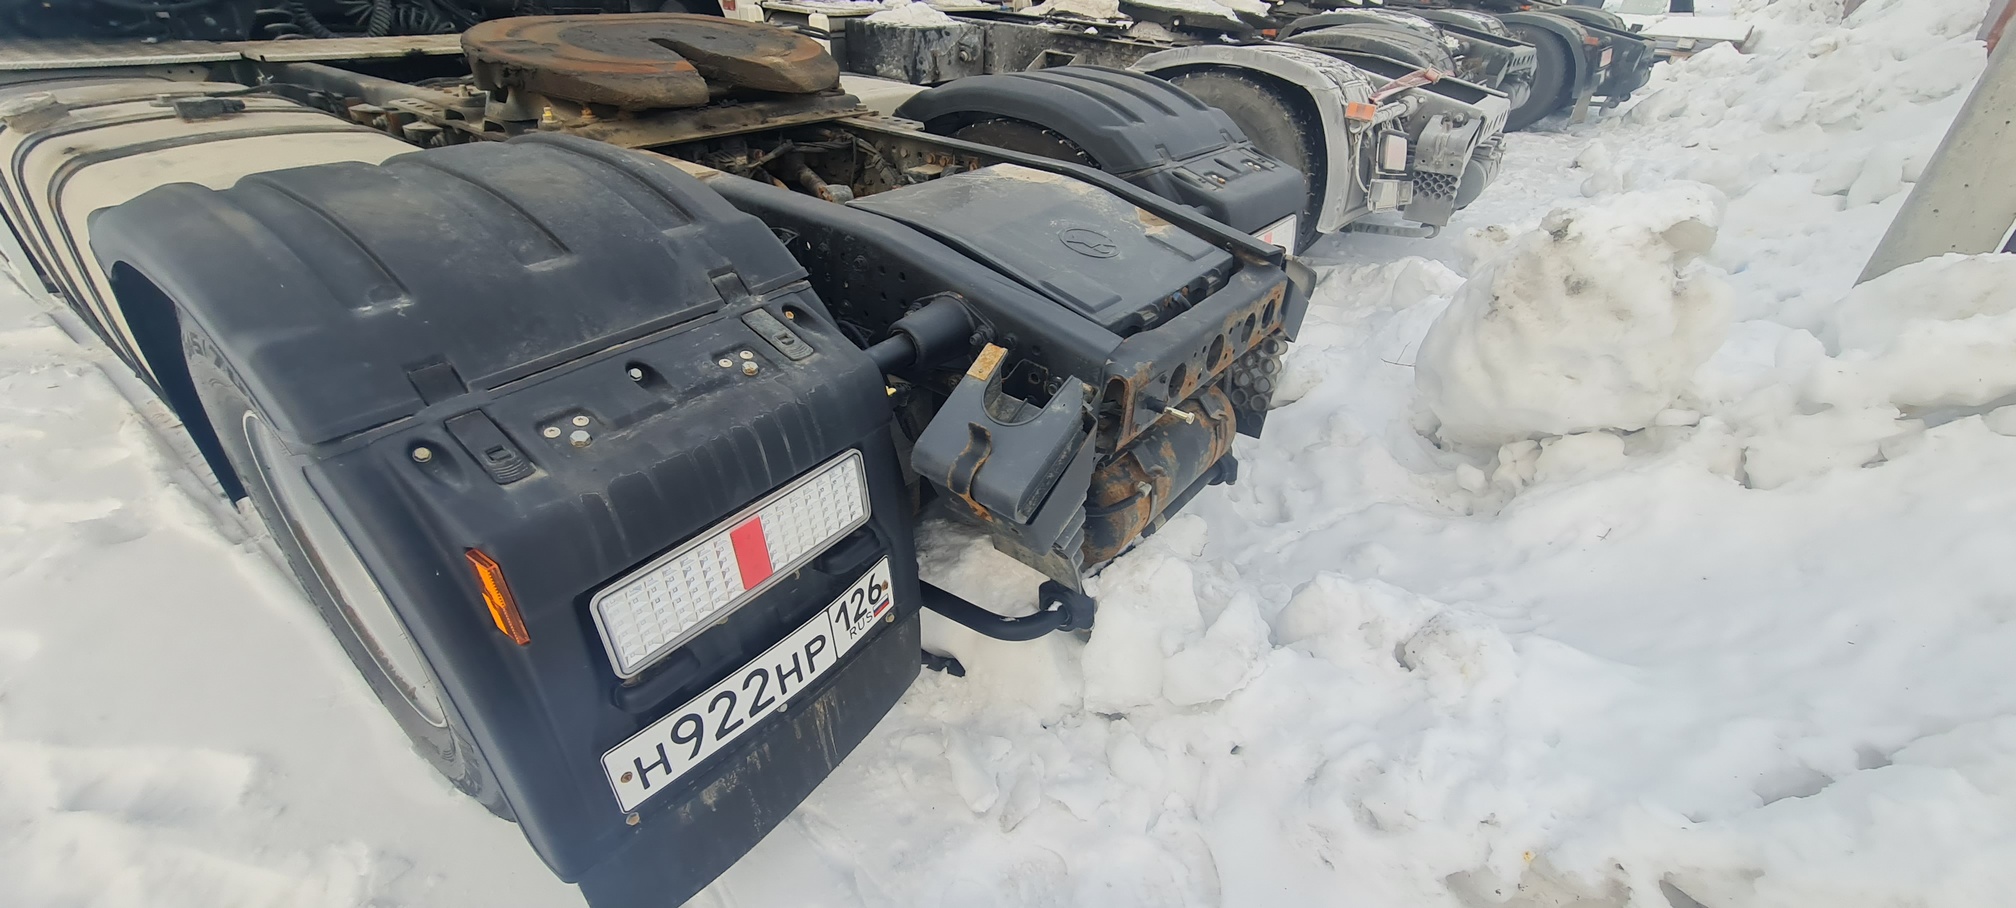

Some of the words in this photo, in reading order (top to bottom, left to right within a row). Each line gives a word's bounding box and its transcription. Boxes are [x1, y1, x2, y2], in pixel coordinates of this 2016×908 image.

[633, 634, 826, 790] Н922НР
[835, 572, 882, 631] 126
[849, 611, 873, 640] RUS
